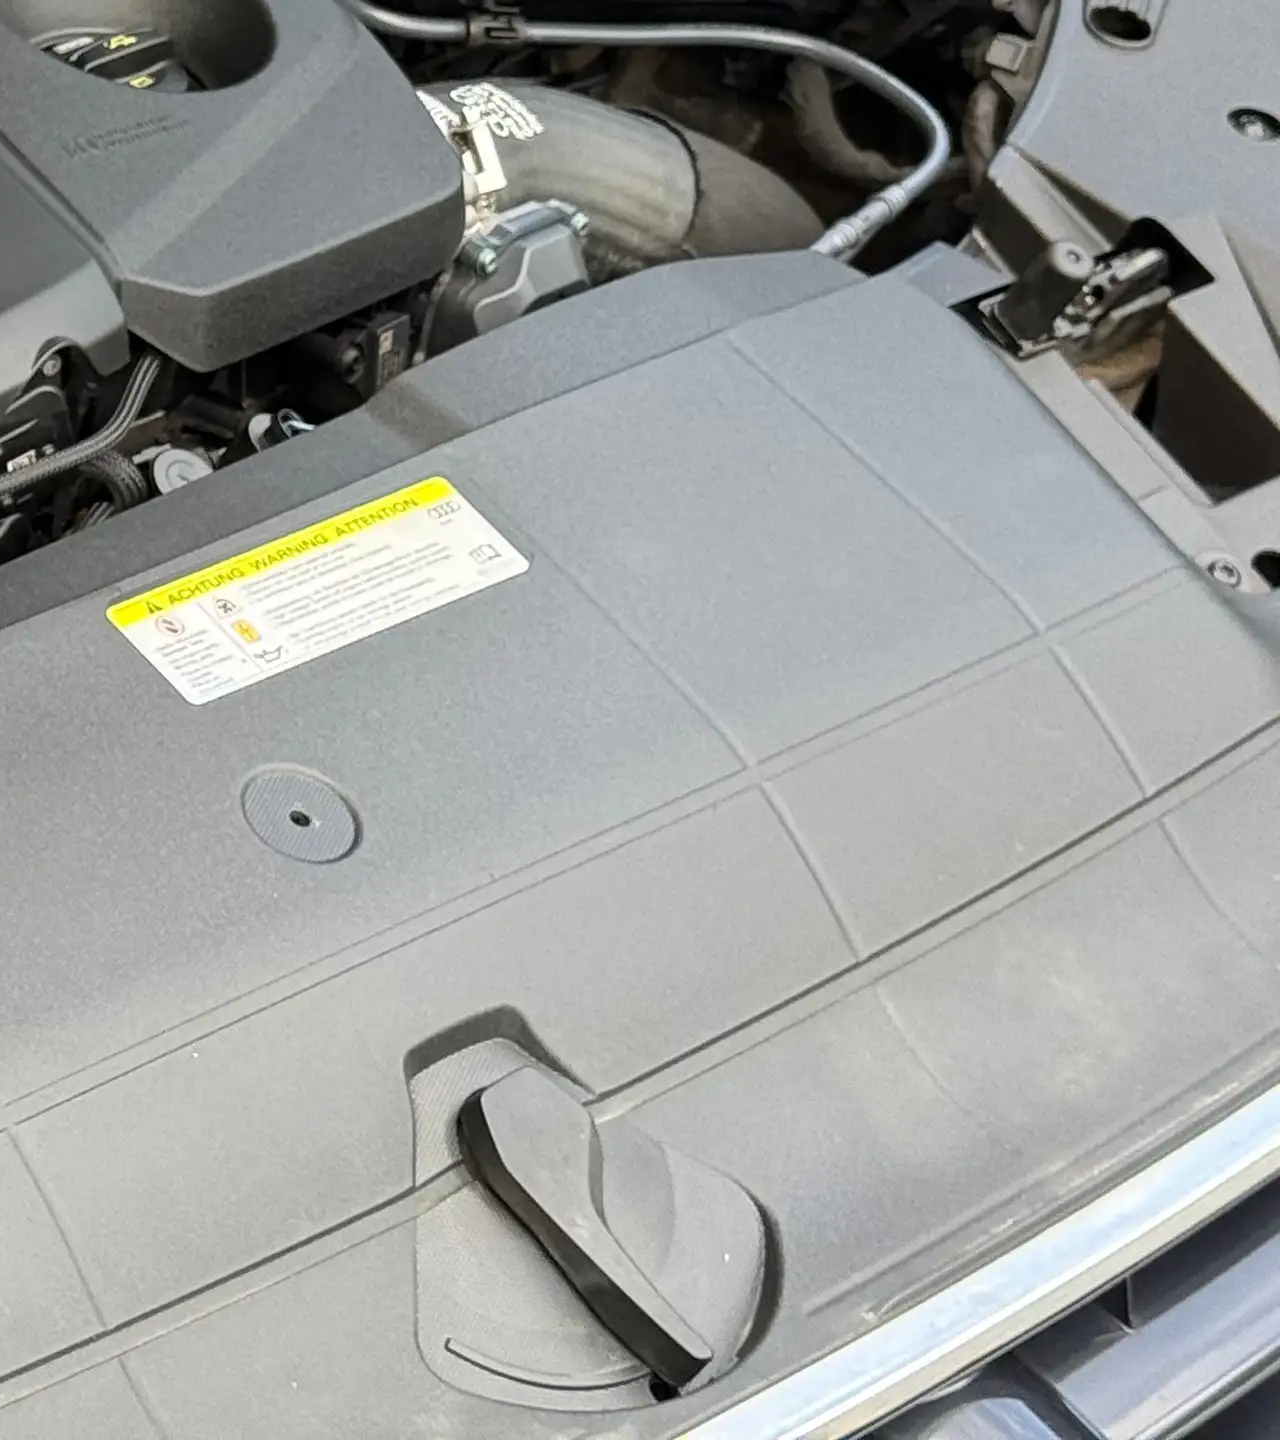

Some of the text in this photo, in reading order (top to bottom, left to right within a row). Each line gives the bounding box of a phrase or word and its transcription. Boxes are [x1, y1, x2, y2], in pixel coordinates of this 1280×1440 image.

[168, 567, 245, 606] ACHTUNG
[249, 532, 329, 570] WARNING
[335, 497, 419, 536] ATTENTION
